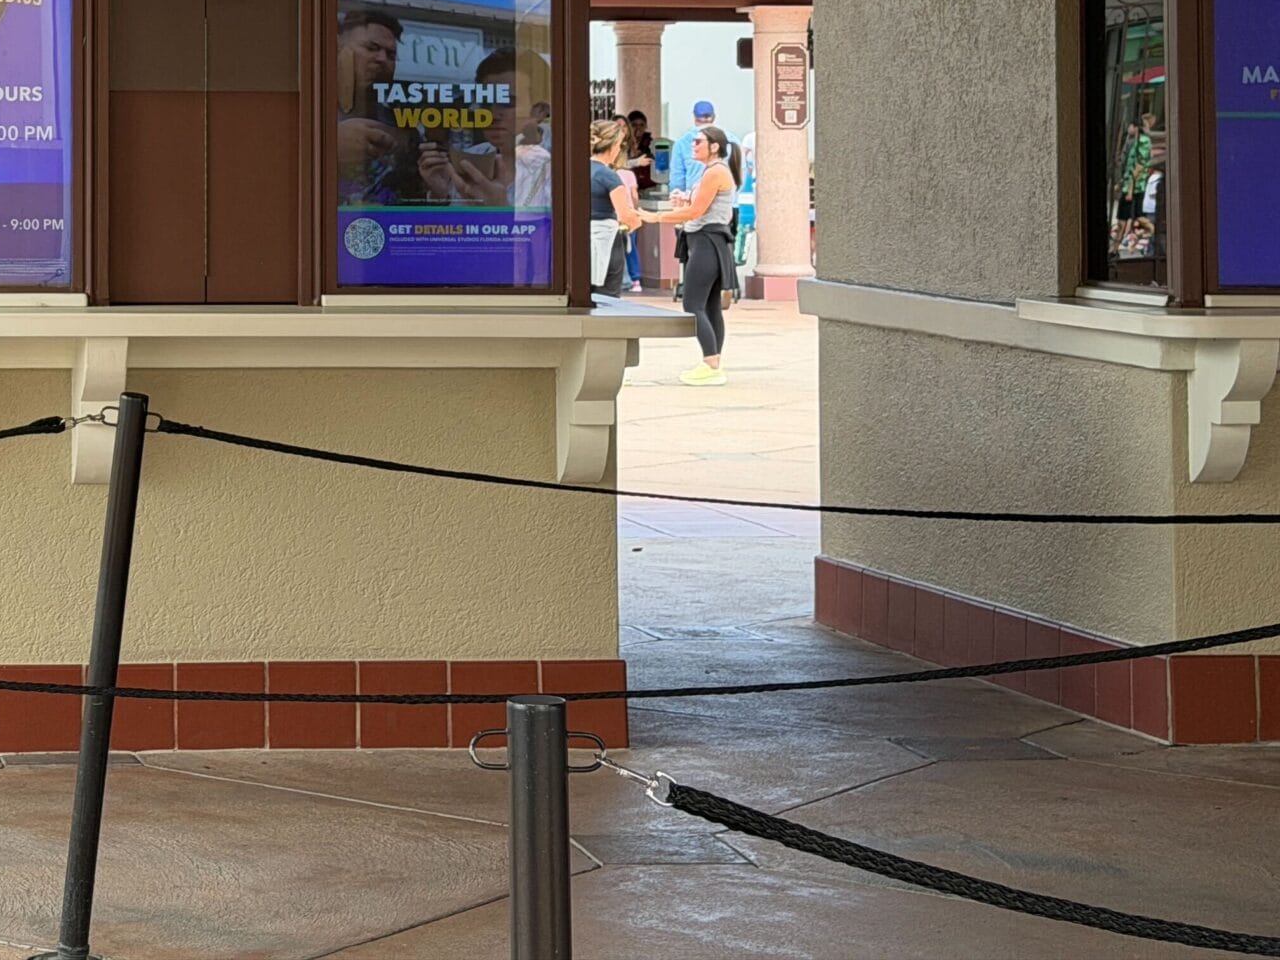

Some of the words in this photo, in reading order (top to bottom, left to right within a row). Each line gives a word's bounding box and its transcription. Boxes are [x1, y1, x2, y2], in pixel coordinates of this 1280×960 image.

[372, 82, 455, 104] TASTE
[458, 83, 512, 104] THE
[393, 106, 495, 129] WORLD
[23, 125, 54, 142] PM
[10, 218, 41, 232] 9:00
[43, 218, 65, 231] PM
[388, 224, 413, 235] GET
[414, 224, 464, 235] DETAILS
[465, 224, 480, 235] IN
[481, 224, 509, 235] OUR
[510, 224, 537, 235] APP
